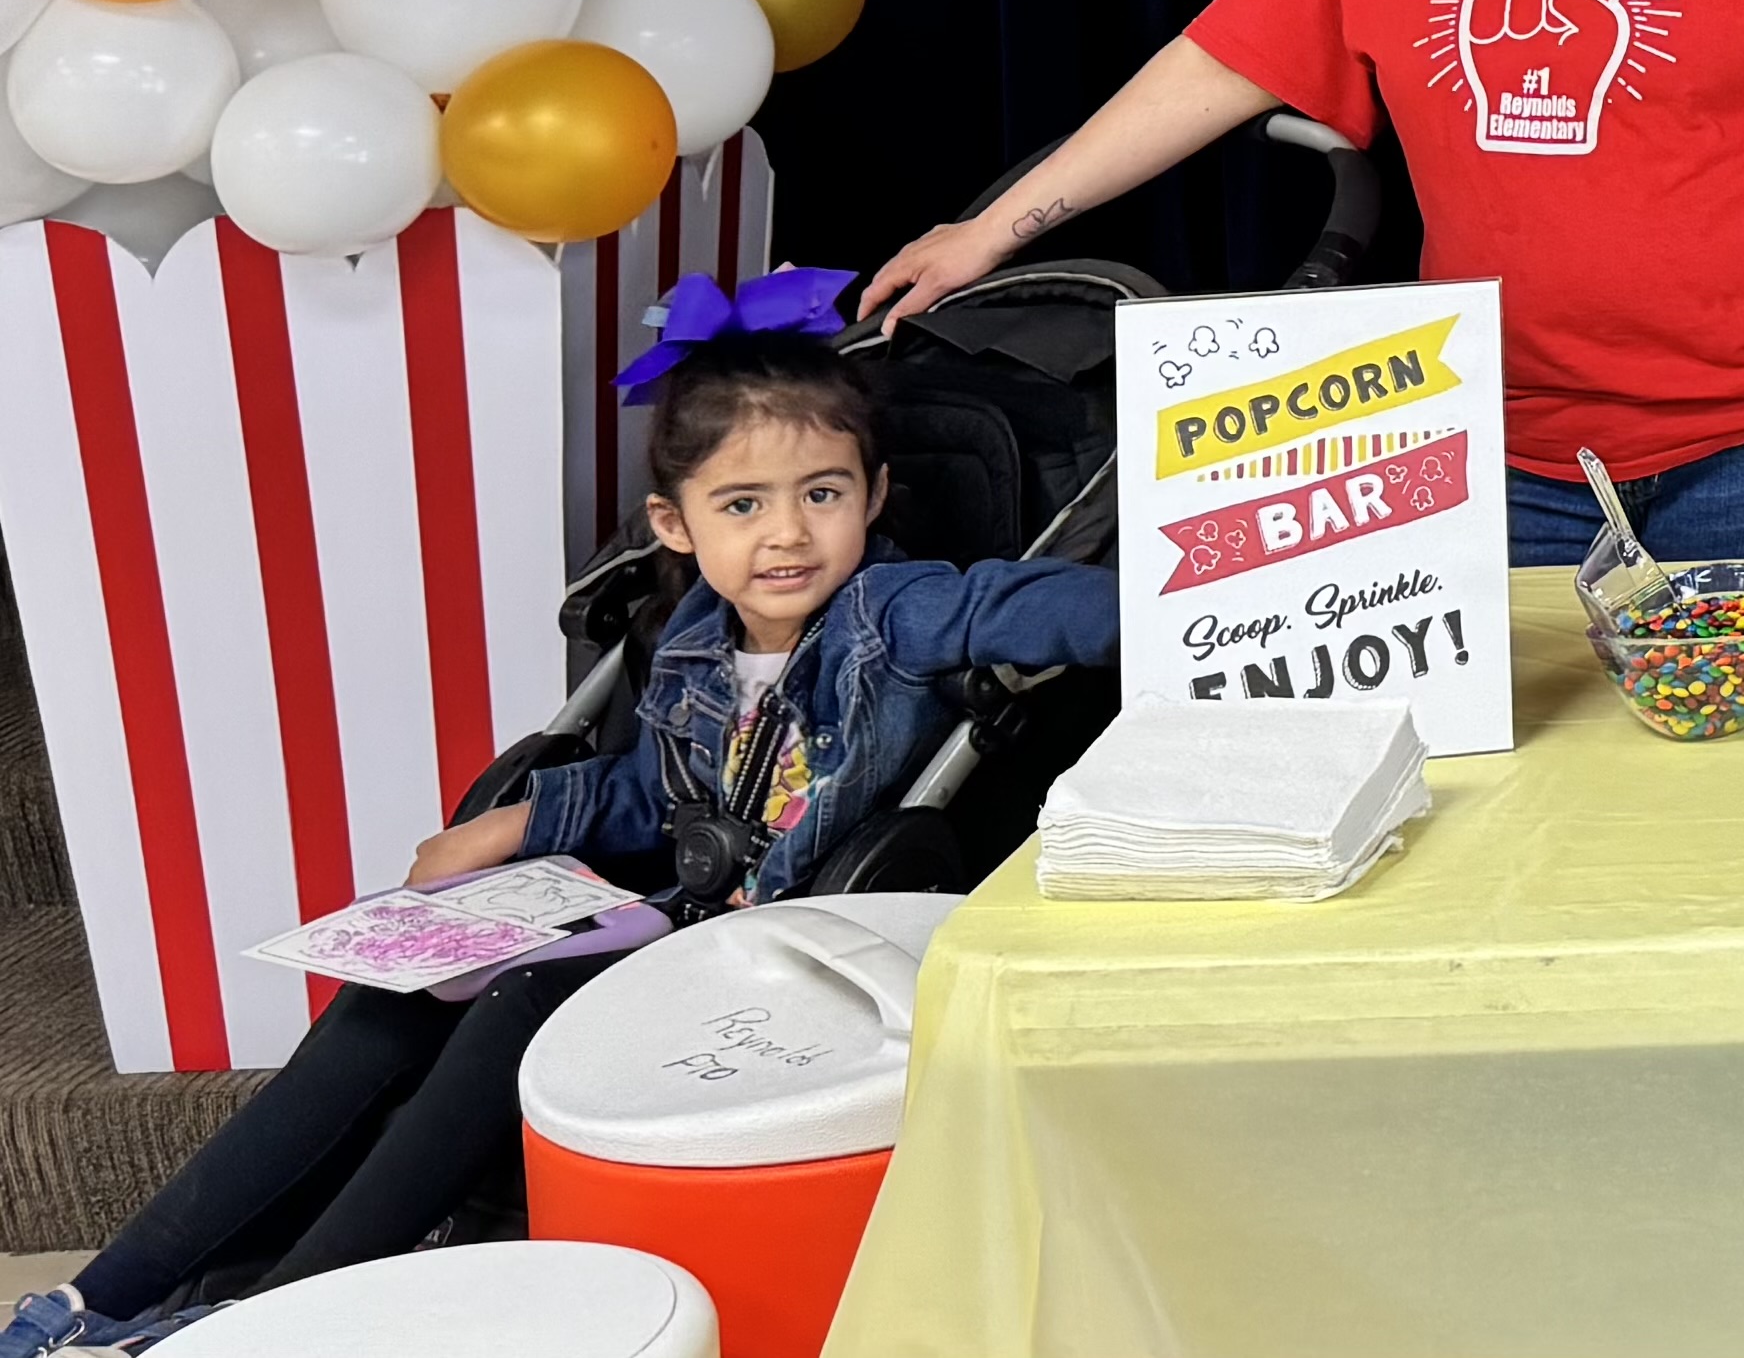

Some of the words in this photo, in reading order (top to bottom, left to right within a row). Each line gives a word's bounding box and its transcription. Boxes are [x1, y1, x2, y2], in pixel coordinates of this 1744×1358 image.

[1500, 92, 1577, 119] Reynolds
[1522, 66, 1550, 96] #1
[1489, 113, 1585, 142] Elementary
[1174, 349, 1426, 459] POPCORN
[1255, 472, 1393, 555] BAR
[1182, 614, 1292, 662] Scoop.
[1304, 570, 1443, 630] Sprinkle.
